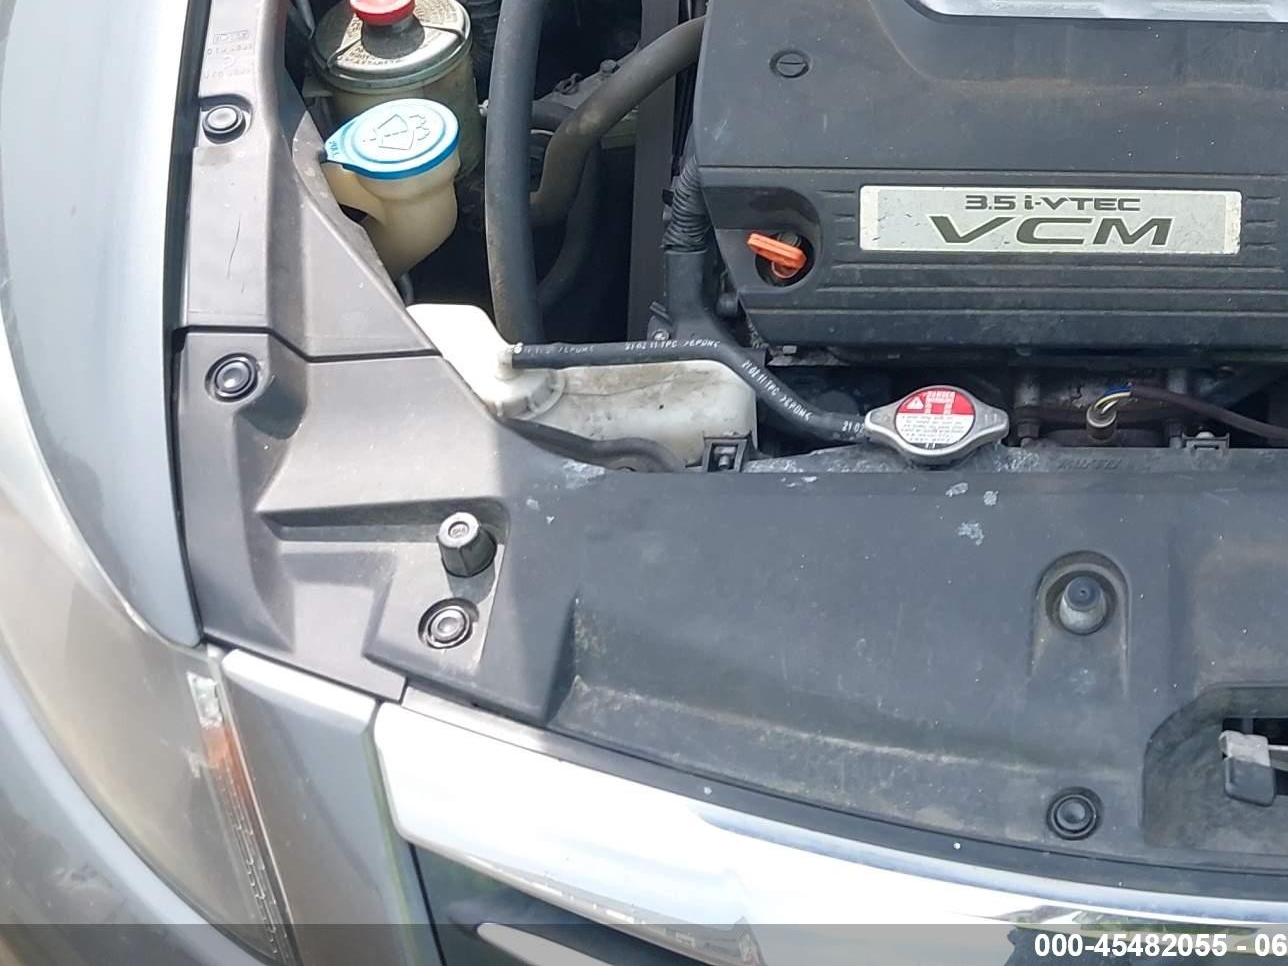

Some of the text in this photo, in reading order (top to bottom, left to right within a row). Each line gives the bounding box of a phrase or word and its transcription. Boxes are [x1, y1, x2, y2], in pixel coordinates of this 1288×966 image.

[965, 195, 1141, 212] 3.5 i-VTEC
[929, 215, 1173, 246] VCM
